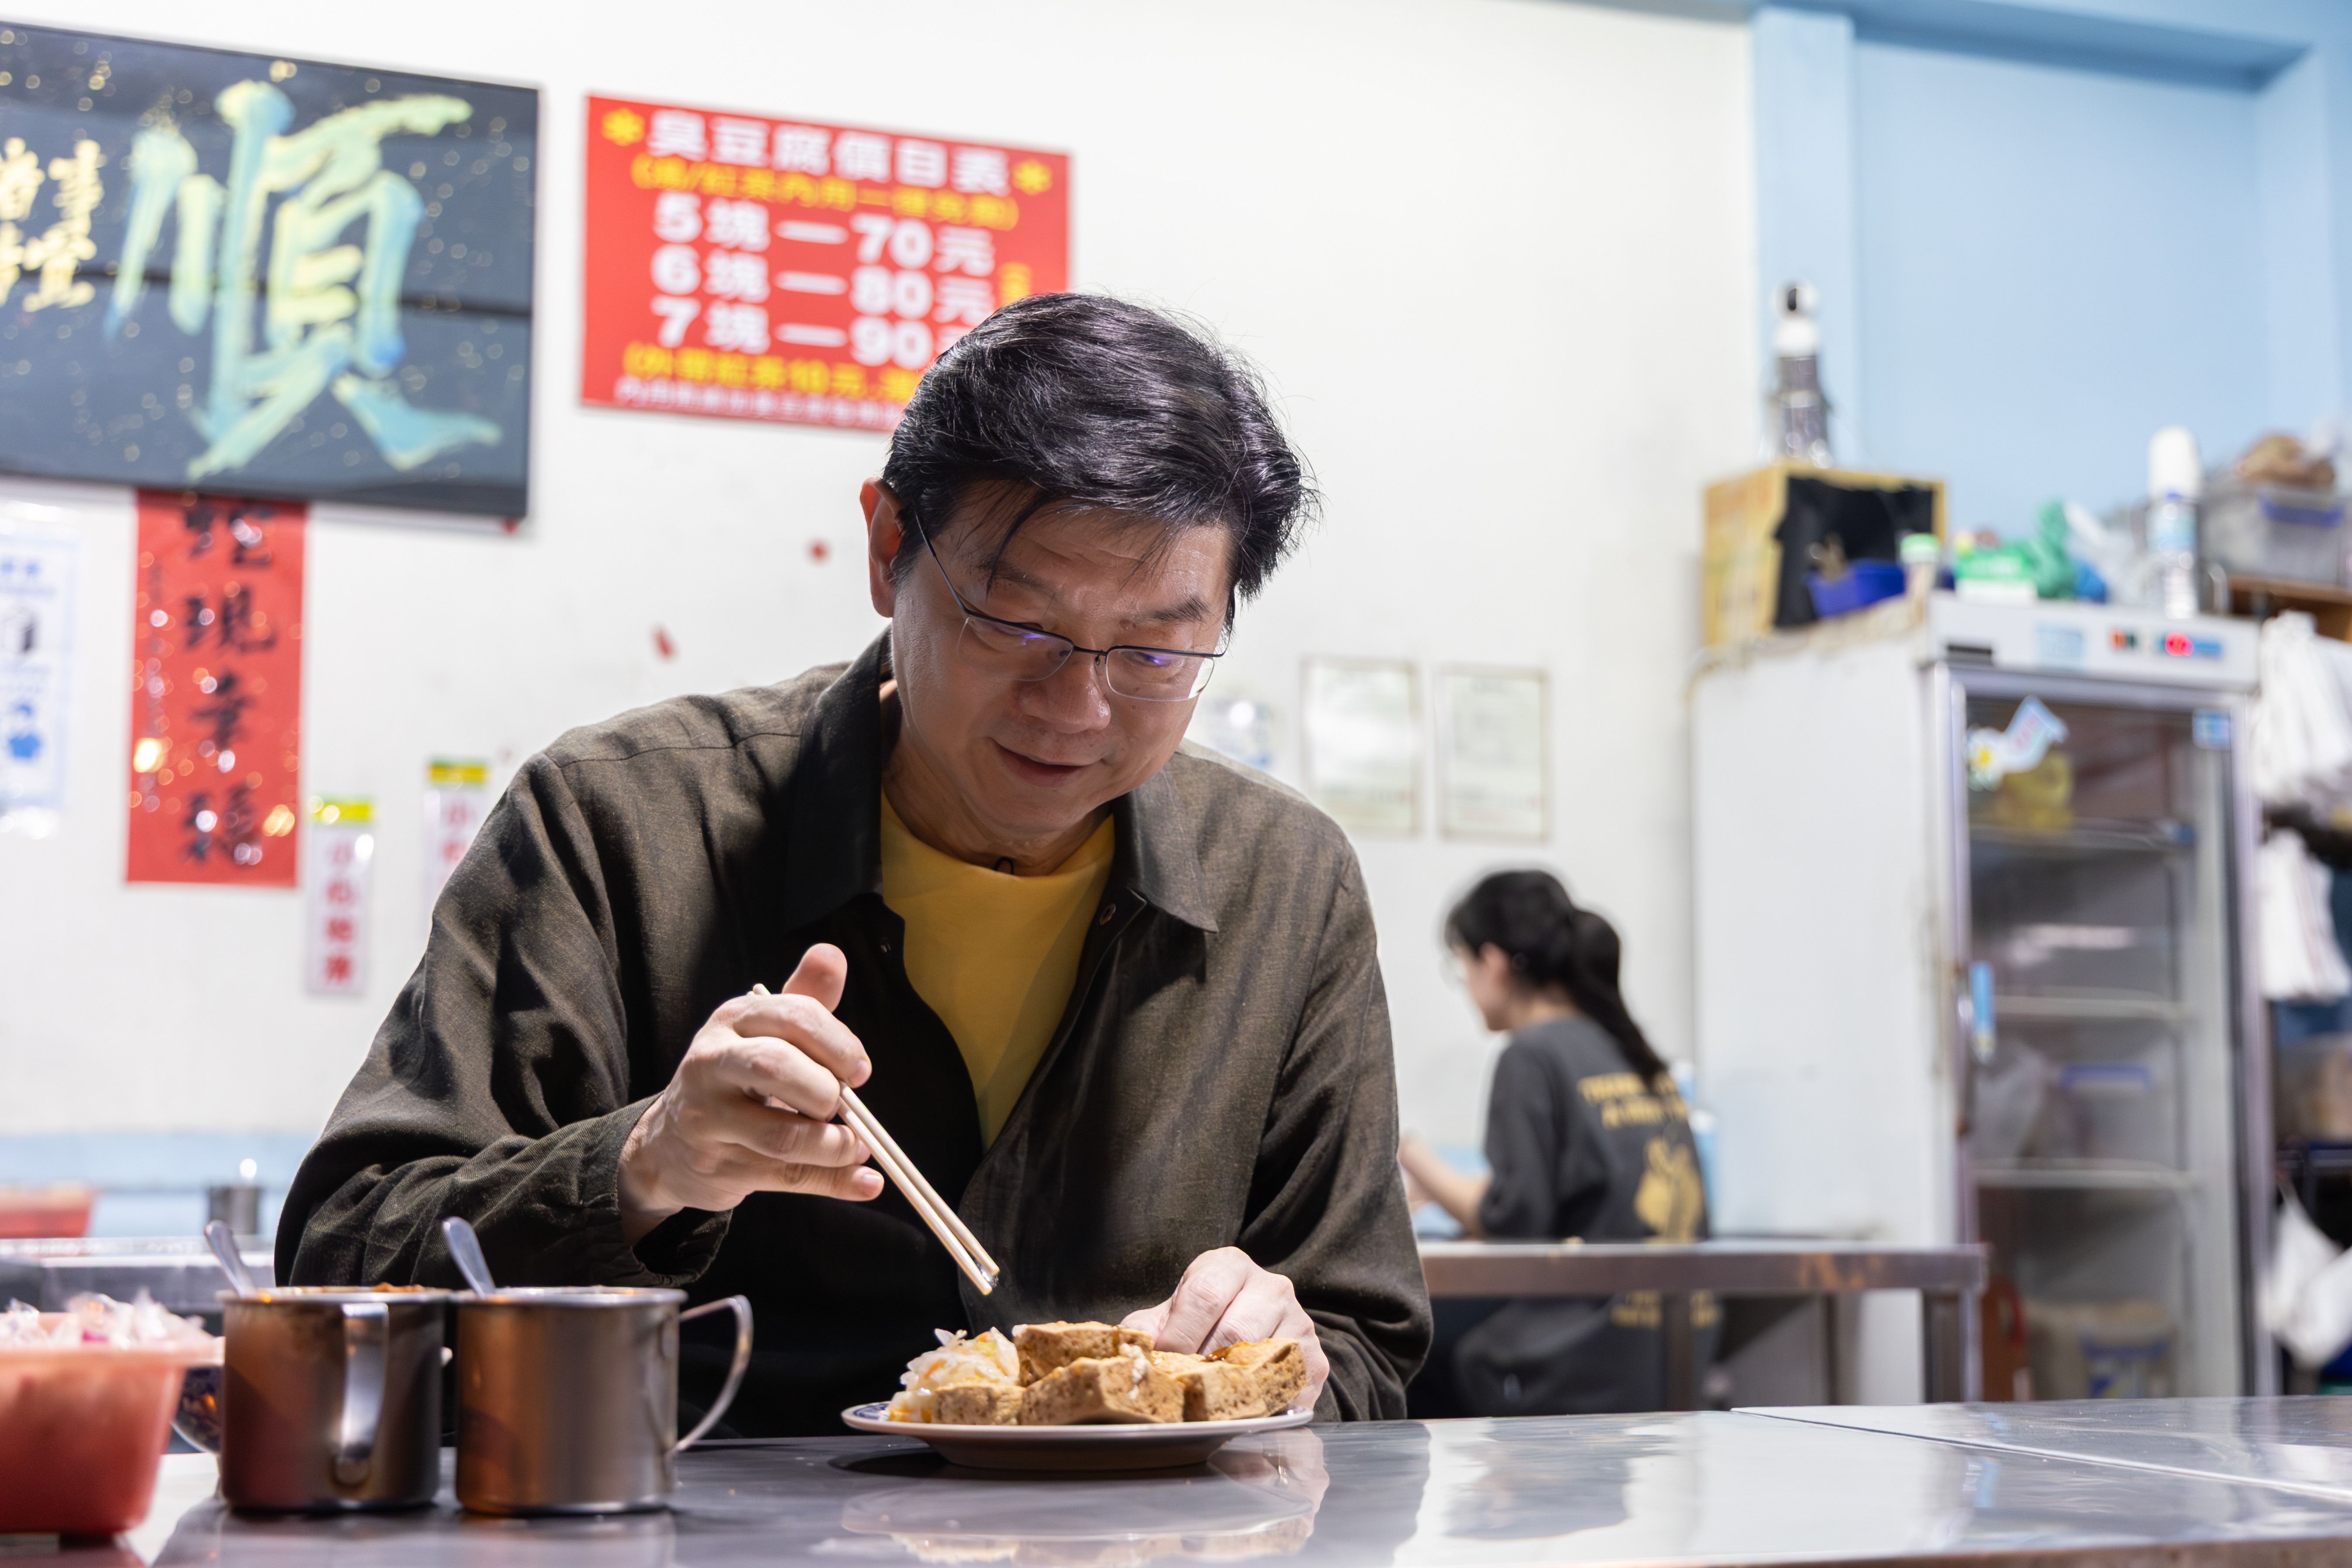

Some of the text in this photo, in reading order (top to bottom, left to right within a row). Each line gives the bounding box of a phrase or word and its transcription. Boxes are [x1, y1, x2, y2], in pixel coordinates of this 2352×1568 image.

[646, 109, 1012, 197] 臭豆腐價目表
[104, 79, 502, 484] 順
